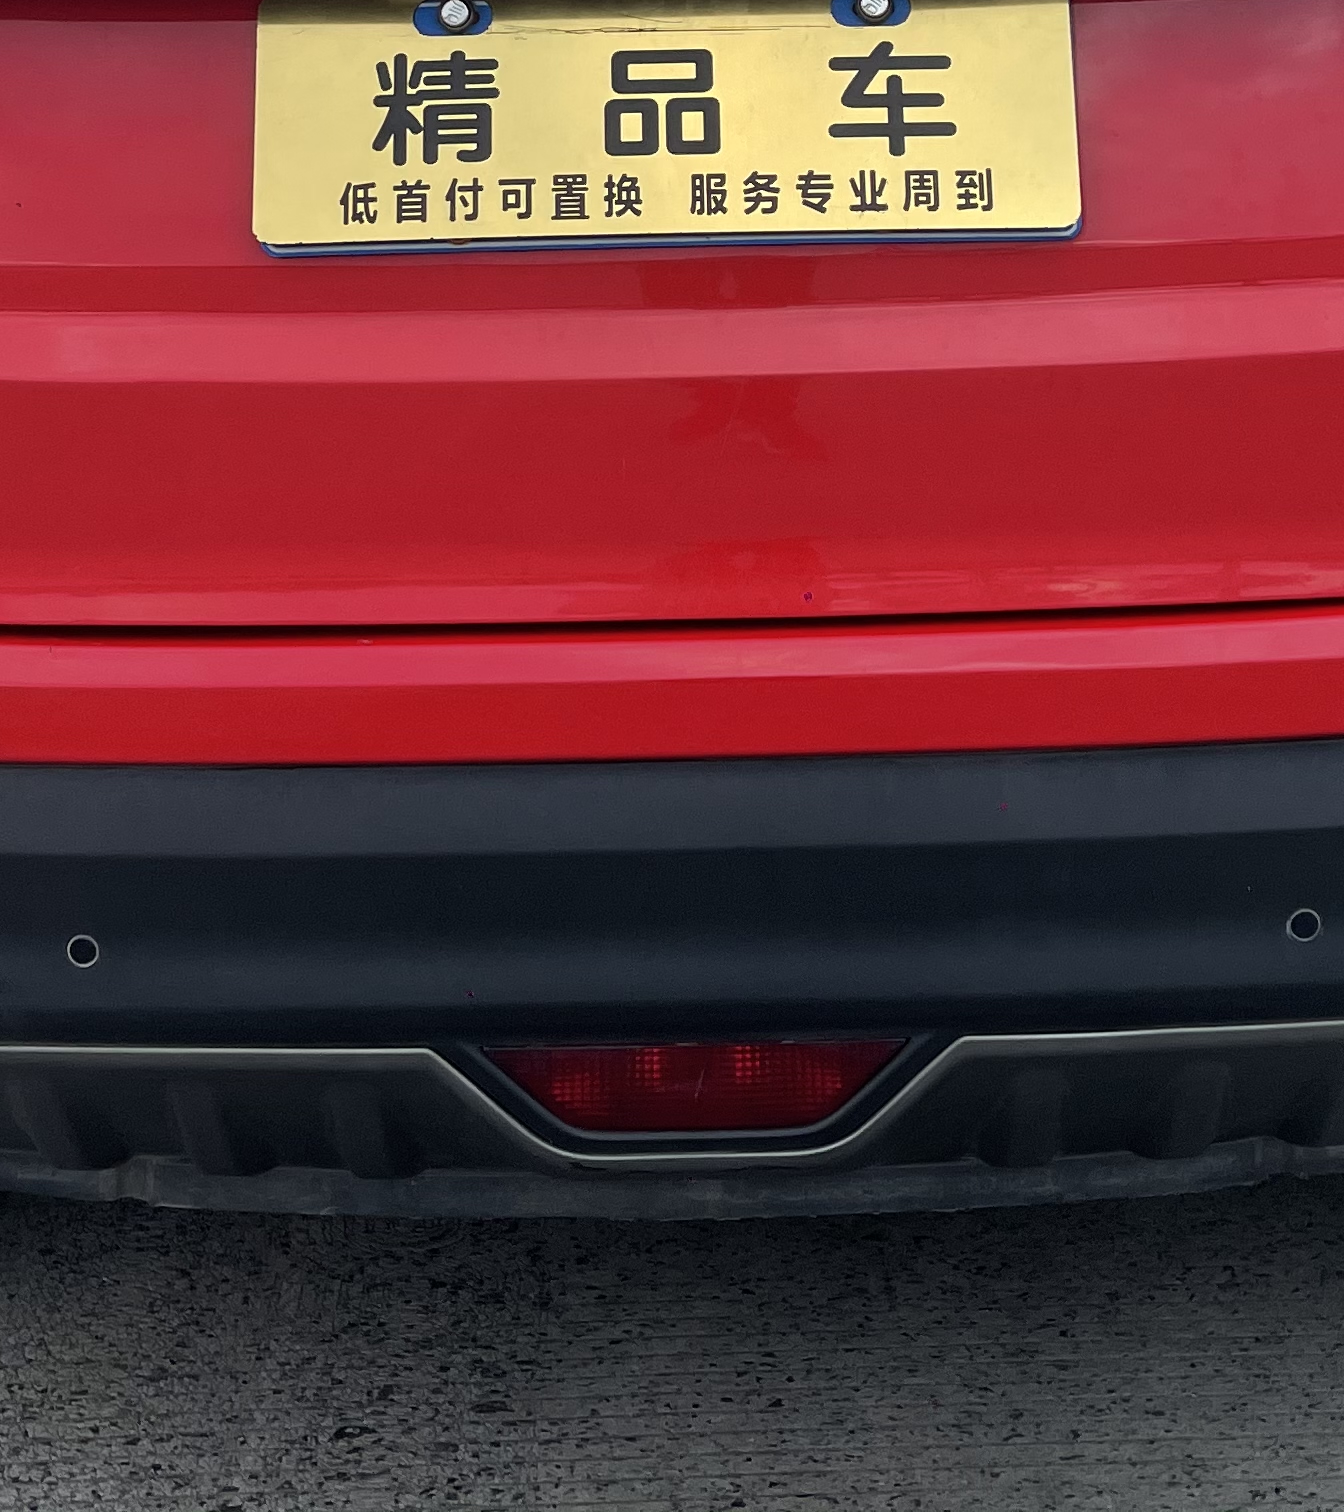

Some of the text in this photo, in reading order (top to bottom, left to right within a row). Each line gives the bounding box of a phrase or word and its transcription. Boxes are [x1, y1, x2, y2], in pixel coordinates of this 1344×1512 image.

[371, 41, 957, 166] 精品车
[339, 167, 994, 225] 低首付可置换 服务专业周到
